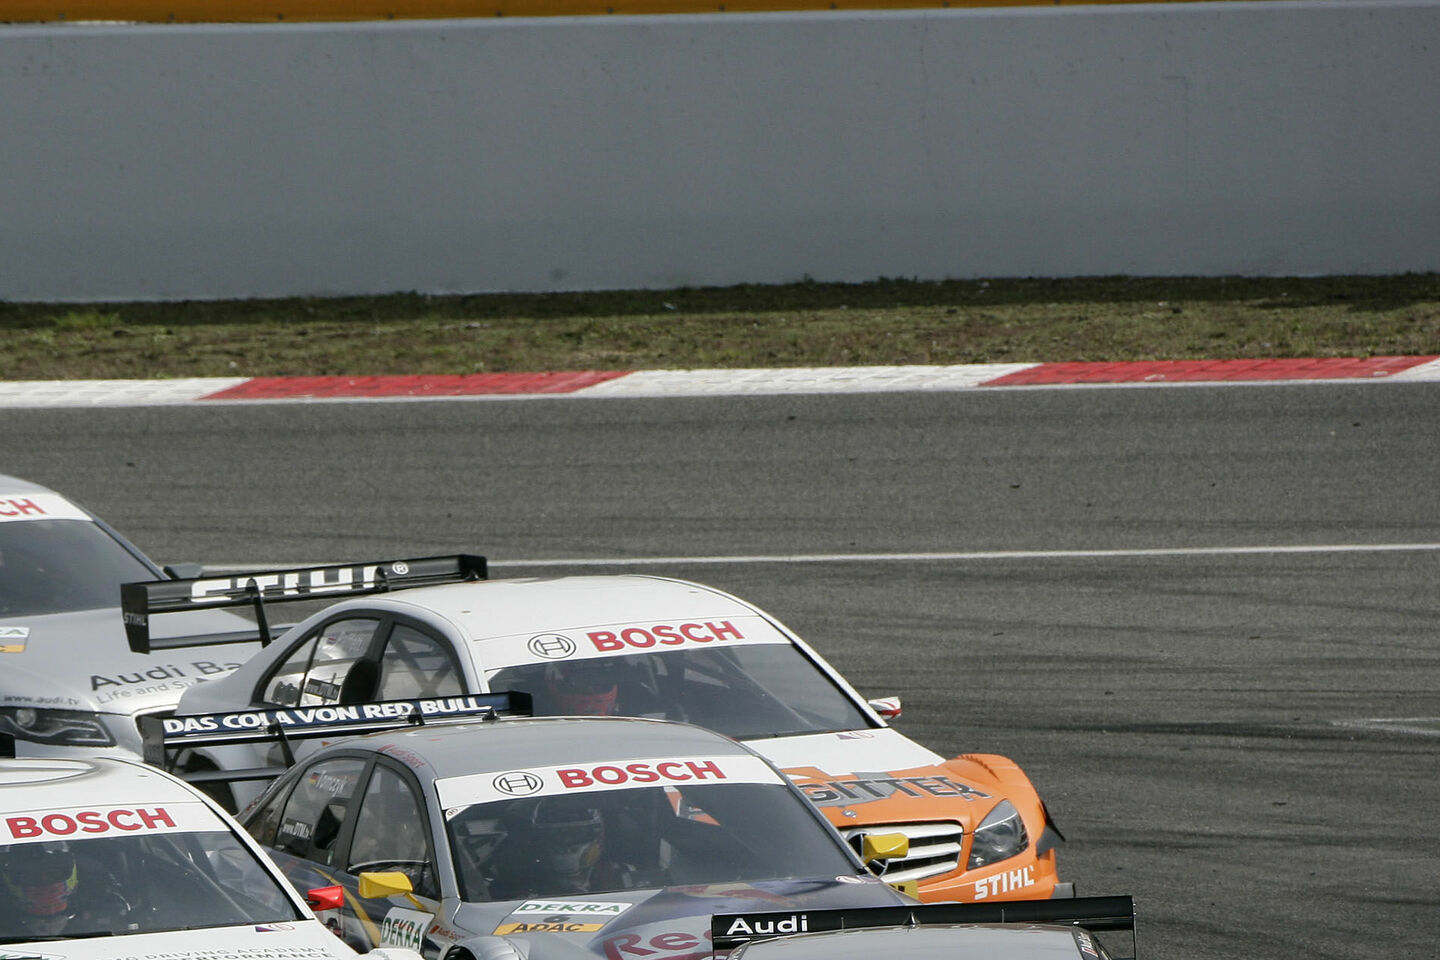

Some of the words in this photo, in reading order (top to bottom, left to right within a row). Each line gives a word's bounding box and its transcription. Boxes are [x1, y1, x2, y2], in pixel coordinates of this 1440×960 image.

[123, 613, 147, 627] STIHL
[586, 620, 745, 652] BOSCH
[90, 664, 186, 691] Audi
[4, 695, 80, 706] www.audi.tv
[96, 691, 131, 704] Life
[136, 683, 169, 695] and
[163, 714, 219, 736] DAS
[294, 705, 361, 724] VON
[362, 702, 414, 719] RED
[420, 696, 492, 715] BULL
[555, 760, 726, 789] BOSCH
[798, 775, 993, 801] GITTER
[5, 807, 178, 839] BOSCH
[974, 869, 1035, 901] STIHL
[519, 902, 621, 914] DEKRA
[382, 917, 423, 949] DEKRA
[511, 922, 585, 933] ADAC
[726, 914, 808, 936] Audi
[149, 949, 228, 960] DRIVING
[237, 946, 327, 955] ACADEMY
